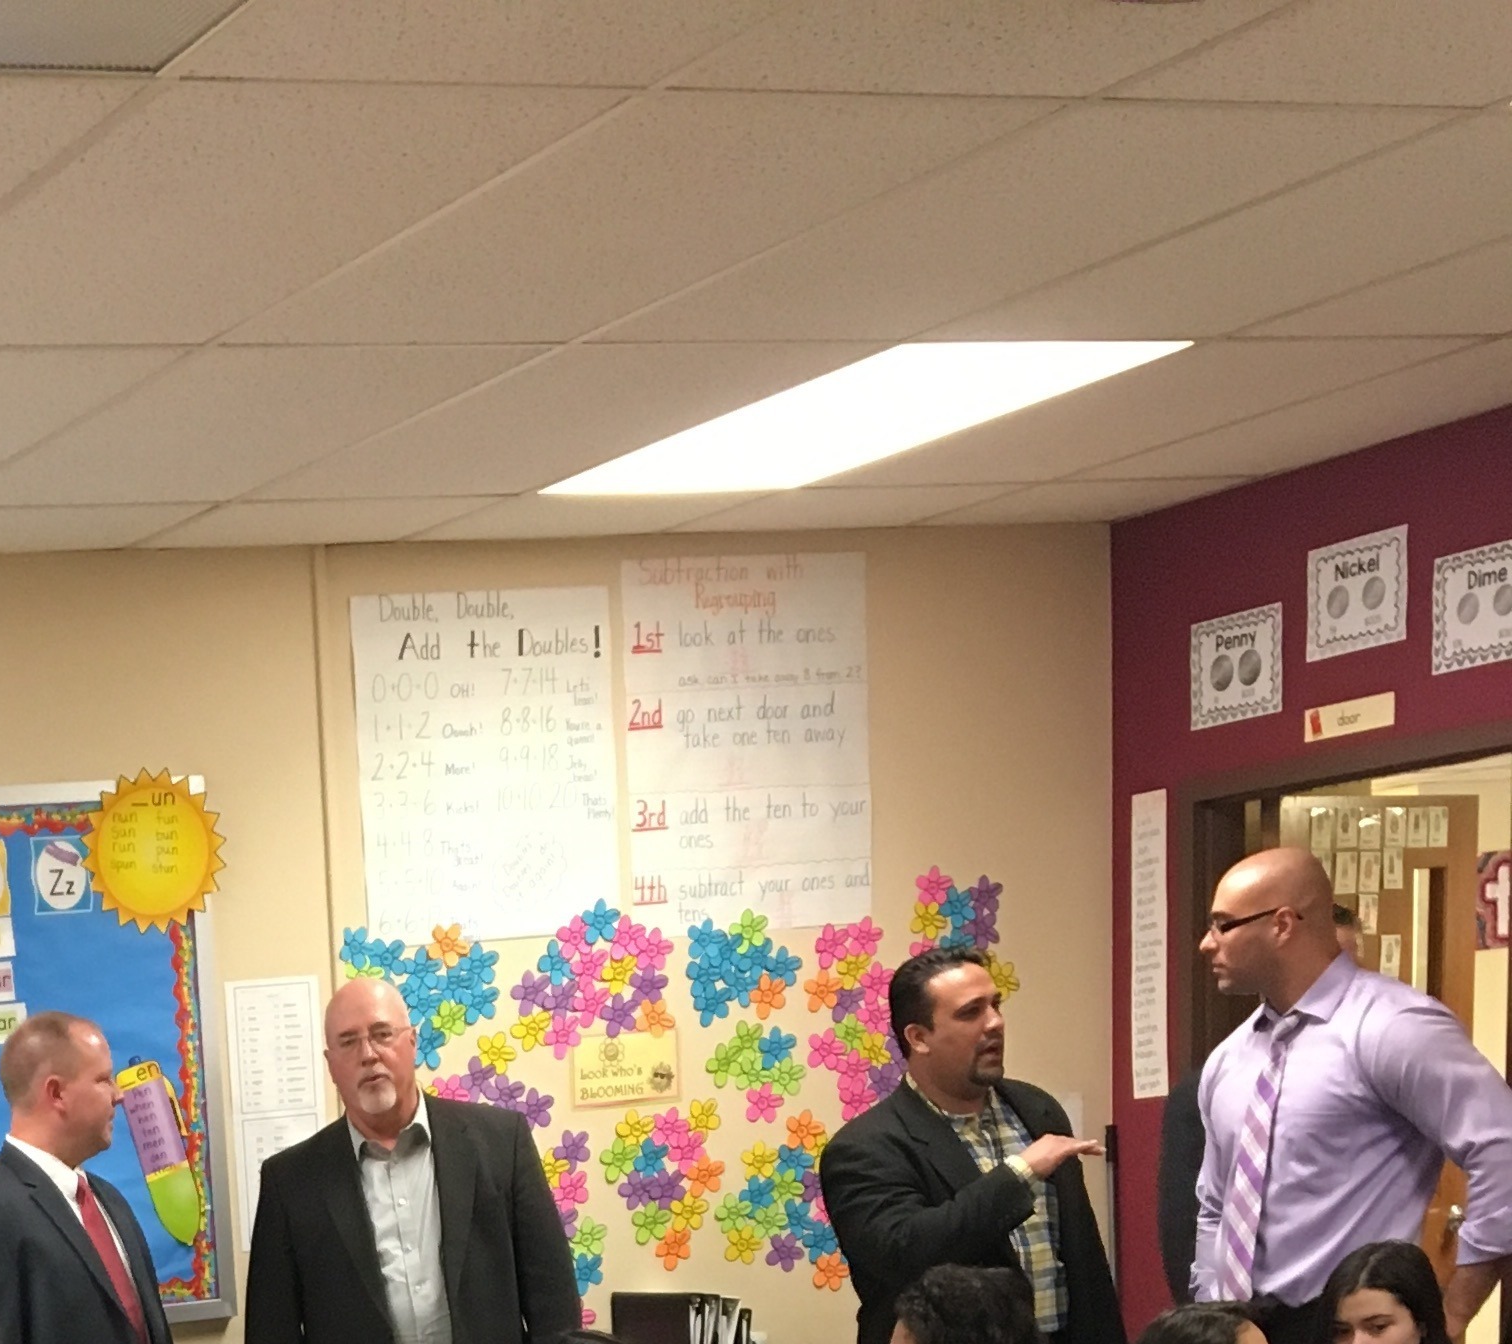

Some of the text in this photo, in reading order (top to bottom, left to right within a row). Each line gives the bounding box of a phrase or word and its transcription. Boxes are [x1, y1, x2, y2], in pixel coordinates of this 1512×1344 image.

[639, 554, 804, 585] Subtraction with
[1335, 553, 1380, 581] Nickel
[1468, 566, 1508, 590] Dime
[398, 632, 440, 660] Add
[467, 630, 501, 658] the
[632, 616, 836, 653] 1st look at the ones
[1216, 631, 1257, 653] Penny
[629, 691, 836, 732] 2nd go next door and
[1338, 711, 1361, 726] door
[684, 724, 846, 748] take one ten away
[634, 793, 866, 831] 3rd add the ten to your
[680, 833, 714, 849] ones
[49, 868, 76, 896] Zz
[634, 863, 871, 903] 4th subtract your ones and
